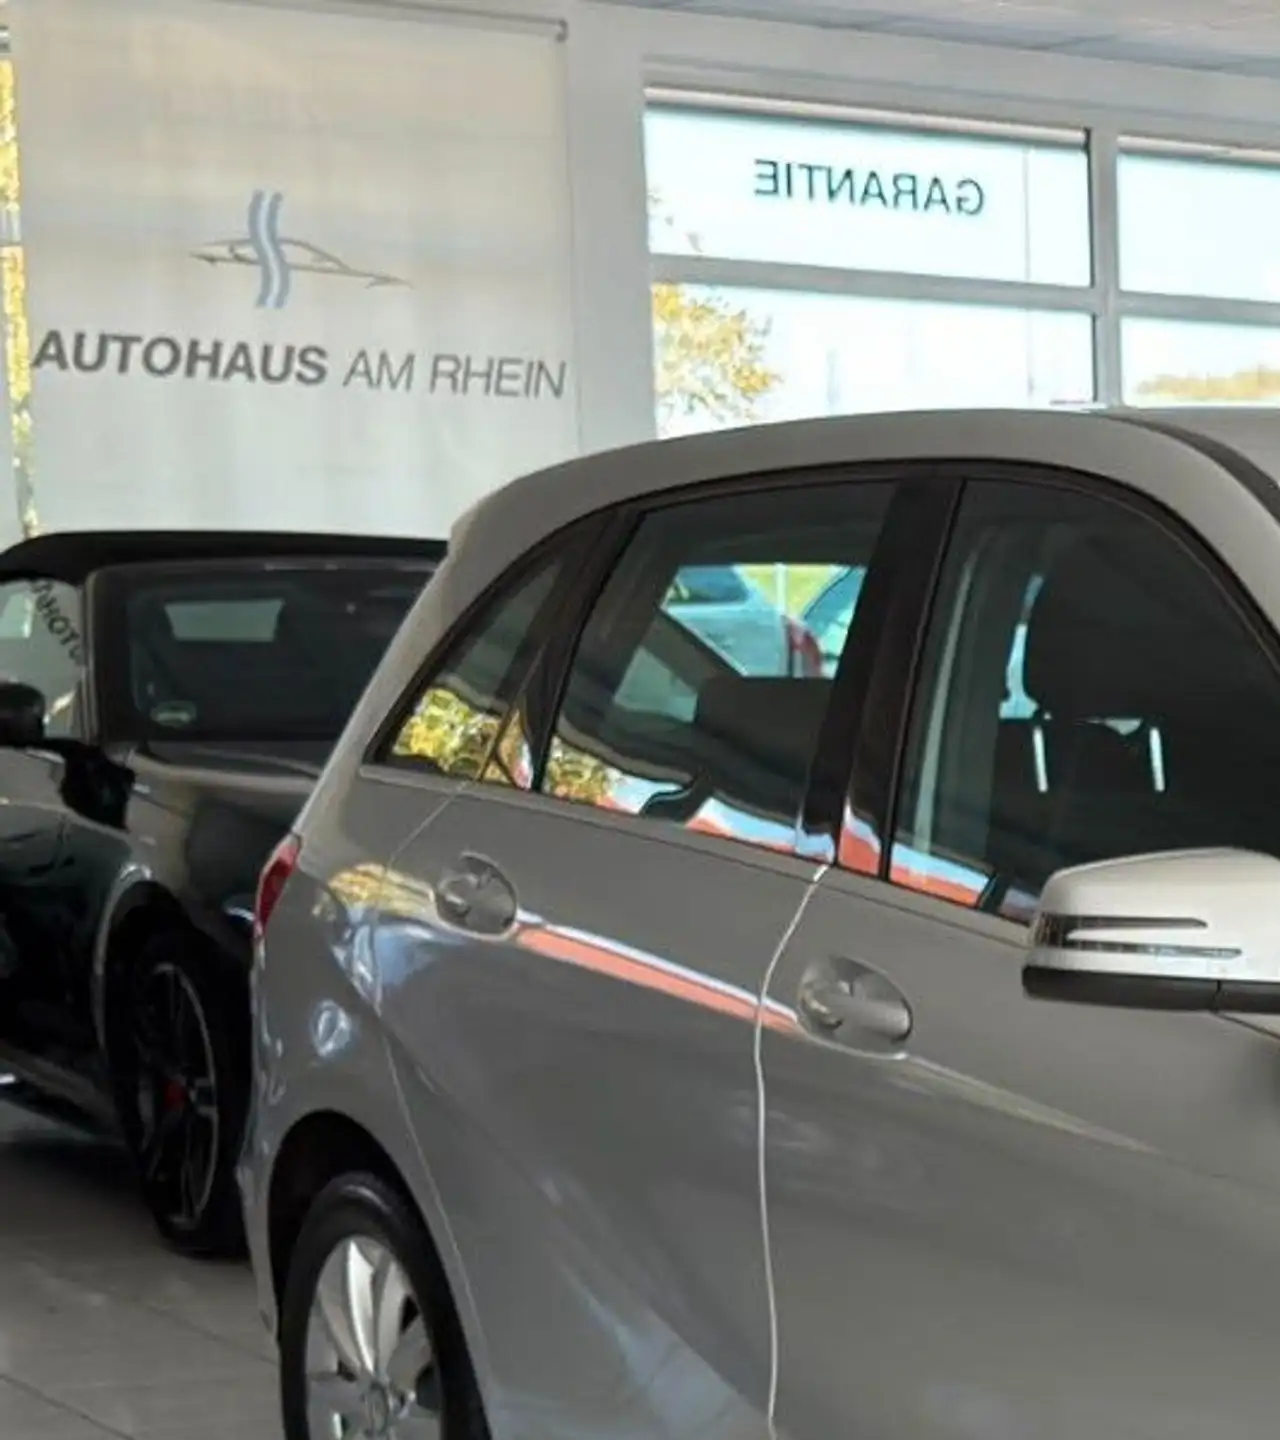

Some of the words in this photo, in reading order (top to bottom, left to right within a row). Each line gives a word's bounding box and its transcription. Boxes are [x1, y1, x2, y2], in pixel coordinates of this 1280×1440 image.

[32, 328, 329, 386] AUTOHAUS
[343, 348, 416, 393] AM
[428, 352, 568, 399] RHEIN
